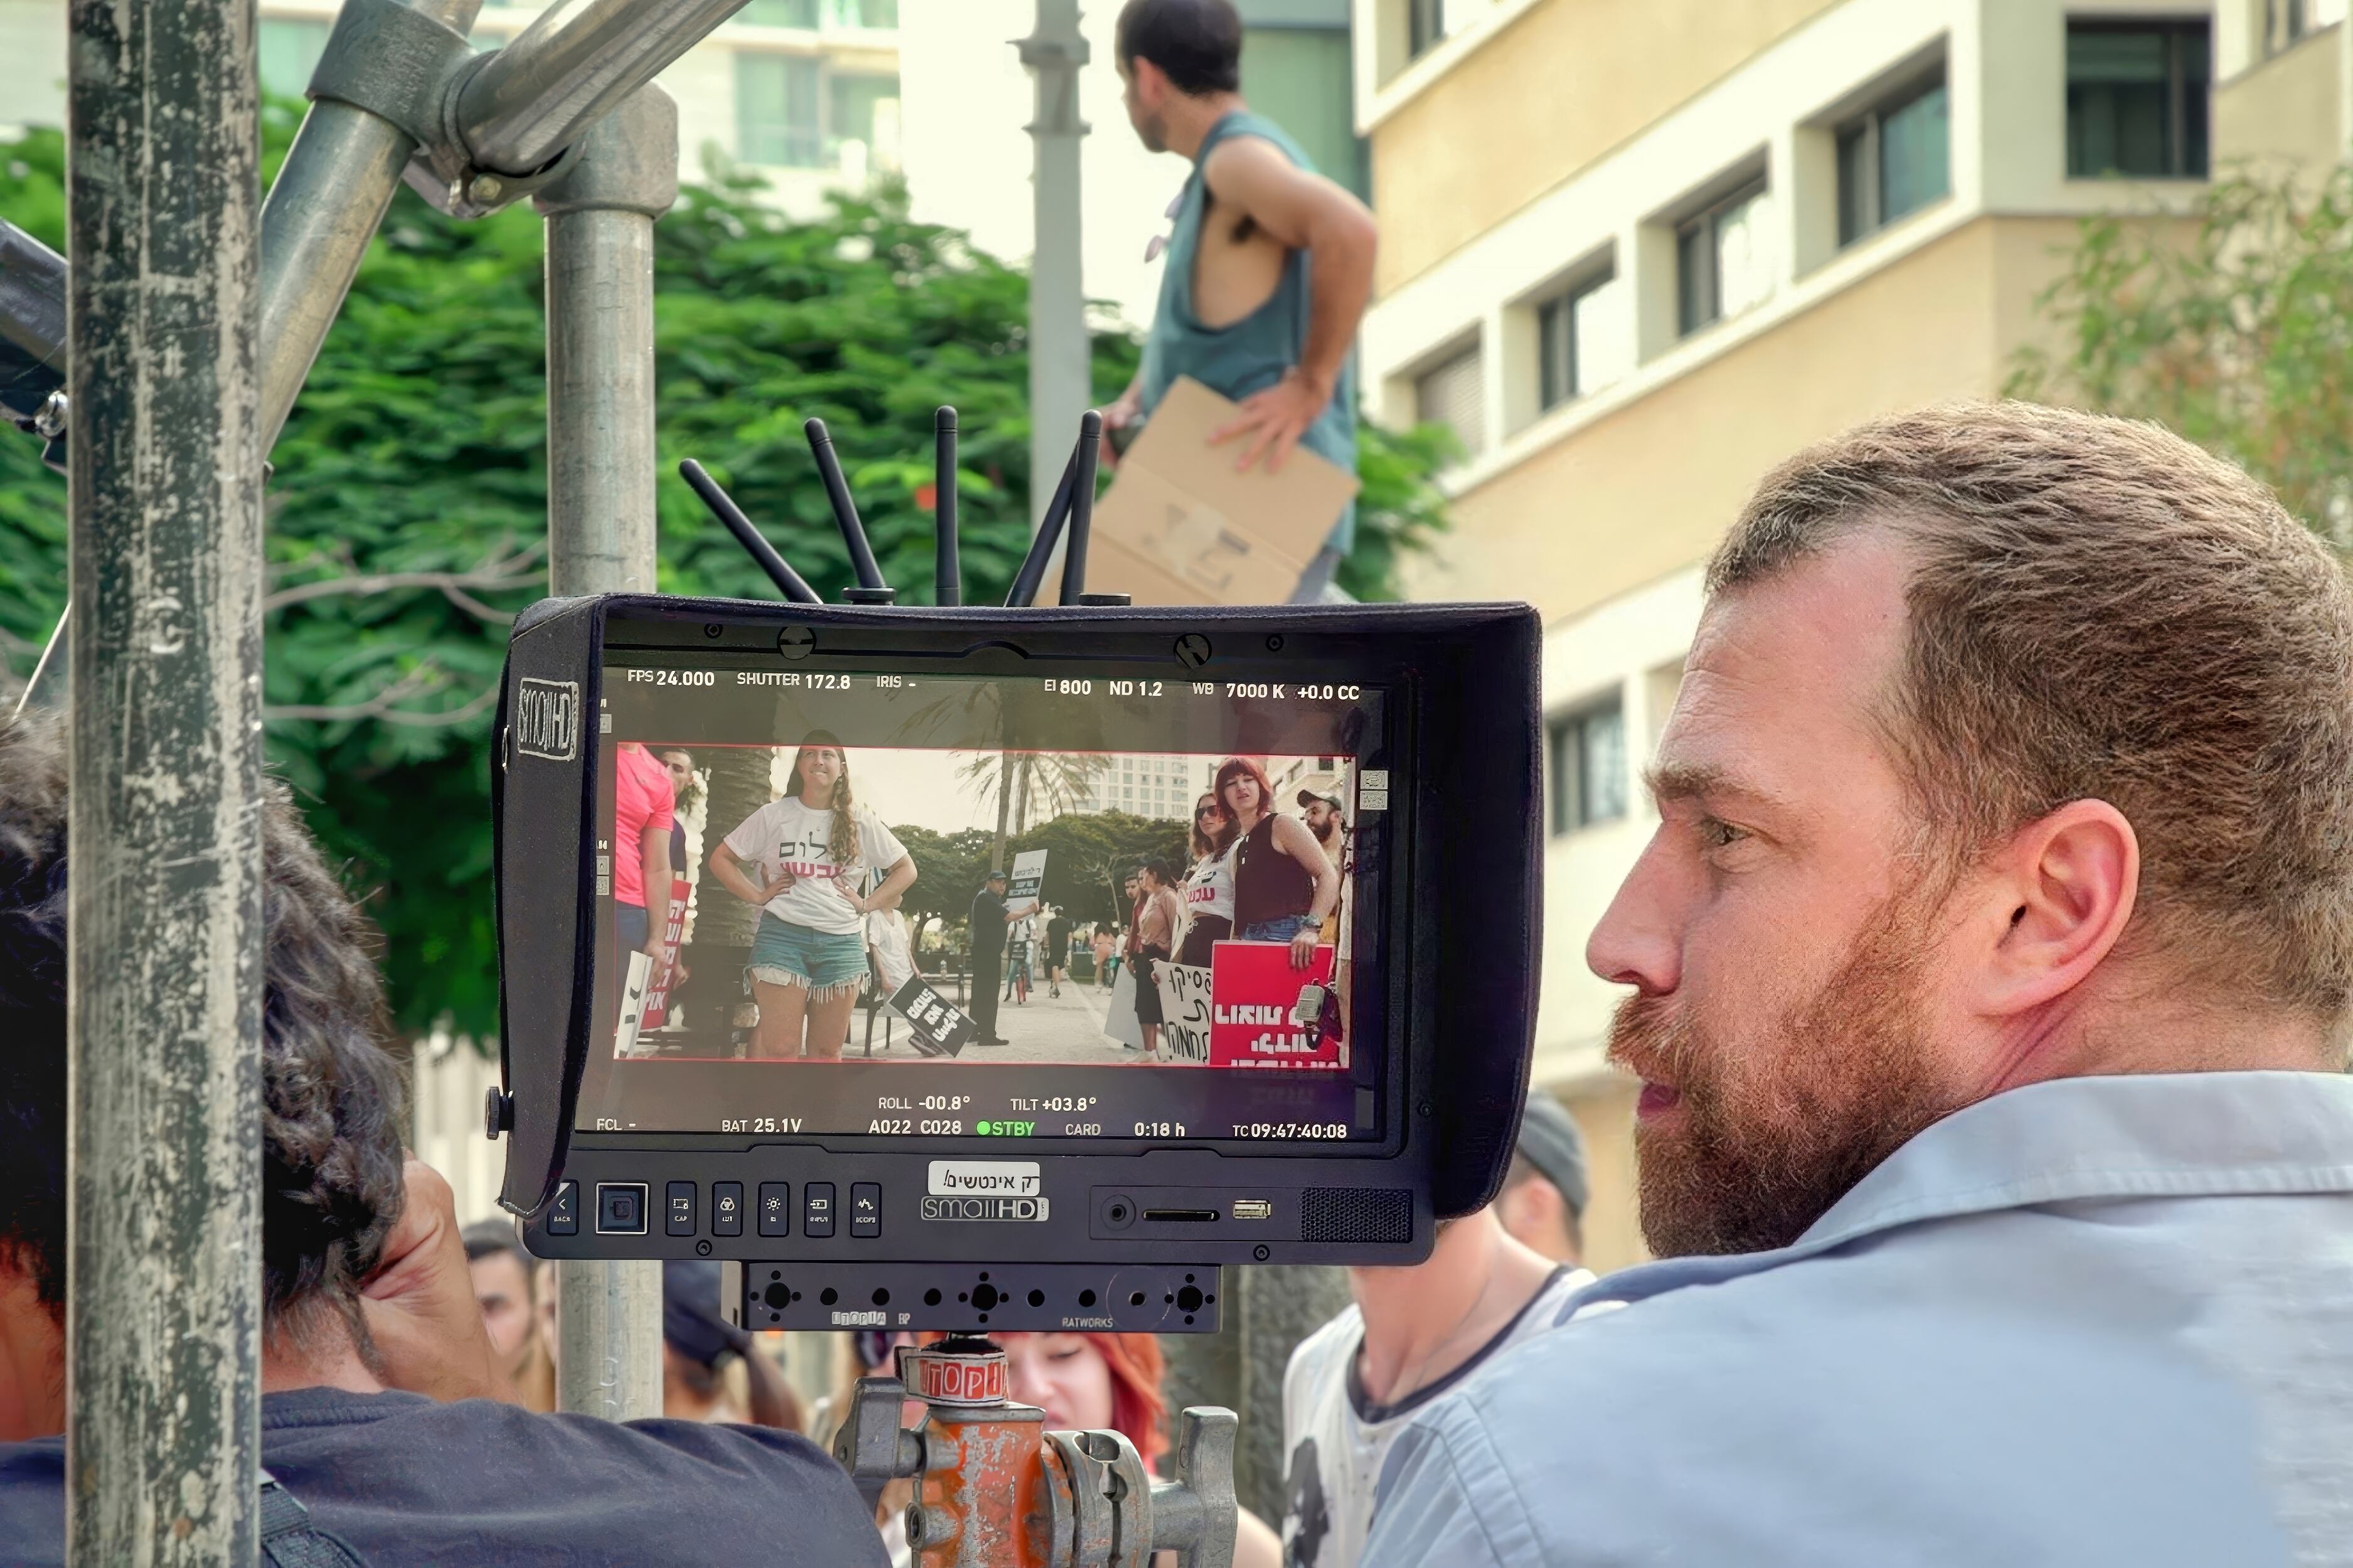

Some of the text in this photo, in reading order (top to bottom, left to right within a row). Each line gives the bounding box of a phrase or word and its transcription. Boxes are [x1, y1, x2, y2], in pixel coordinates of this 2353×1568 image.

[627, 669, 715, 686] FPS 24.000
[736, 672, 851, 689] SHUTTER 172.8
[1060, 680, 1092, 695] 800
[1109, 681, 1163, 697] ND 1.2
[1226, 683, 1268, 698] 7000
[1272, 684, 1285, 699] K
[1297, 684, 1334, 700] +0.0
[1337, 685, 1360, 700] CC
[778, 831, 829, 859] לום
[878, 1096, 970, 1111] ROLL -00.8°
[1010, 1097, 1097, 1111] TILT +03.8°
[597, 1118, 622, 1131] FCL
[721, 1118, 802, 1133] BAT 25.1V
[868, 1119, 962, 1135] A022 C028
[992, 1121, 1035, 1136] STBY
[1065, 1123, 1101, 1136] CARD
[1134, 1122, 1185, 1136] 0:18 h
[1233, 1123, 1347, 1138] TC 09:47:40:08
[924, 1199, 1036, 1219] smallHD
[919, 1359, 1008, 1399] UTOPI
